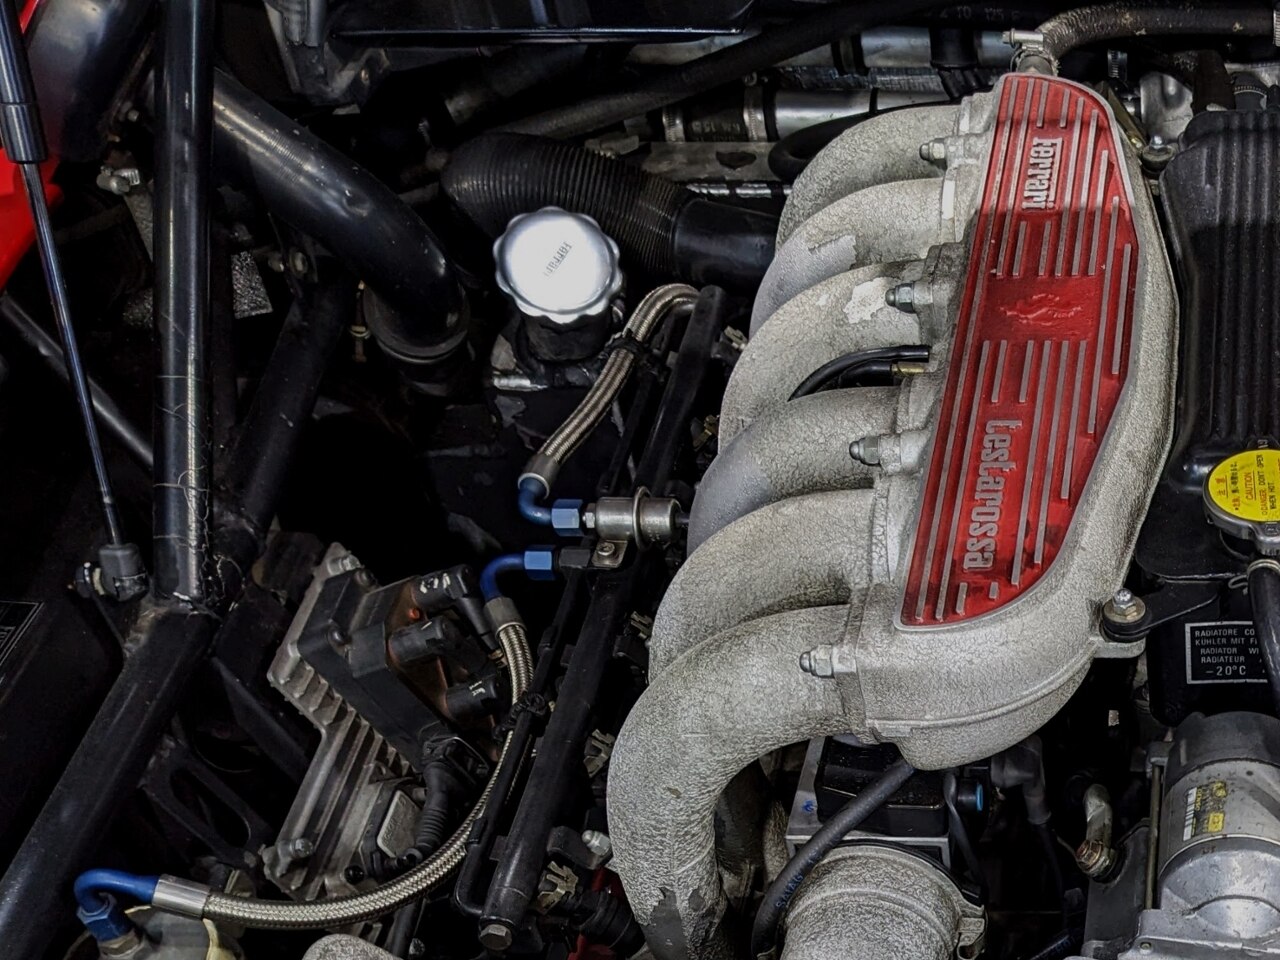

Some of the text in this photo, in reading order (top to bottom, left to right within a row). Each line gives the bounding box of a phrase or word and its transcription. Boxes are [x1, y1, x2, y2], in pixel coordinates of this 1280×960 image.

[1022, 136, 1063, 211] Ferrari
[1256, 454, 1264, 468] OPEN
[1243, 471, 1253, 500] CAUTION
[1194, 628, 1238, 637] RADIATORE
[1195, 637, 1227, 646] KÜHLER
[1230, 637, 1246, 645] MIT
[1200, 647, 1238, 655] RADIATOR
[1200, 655, 1245, 664] RADIATEUR
